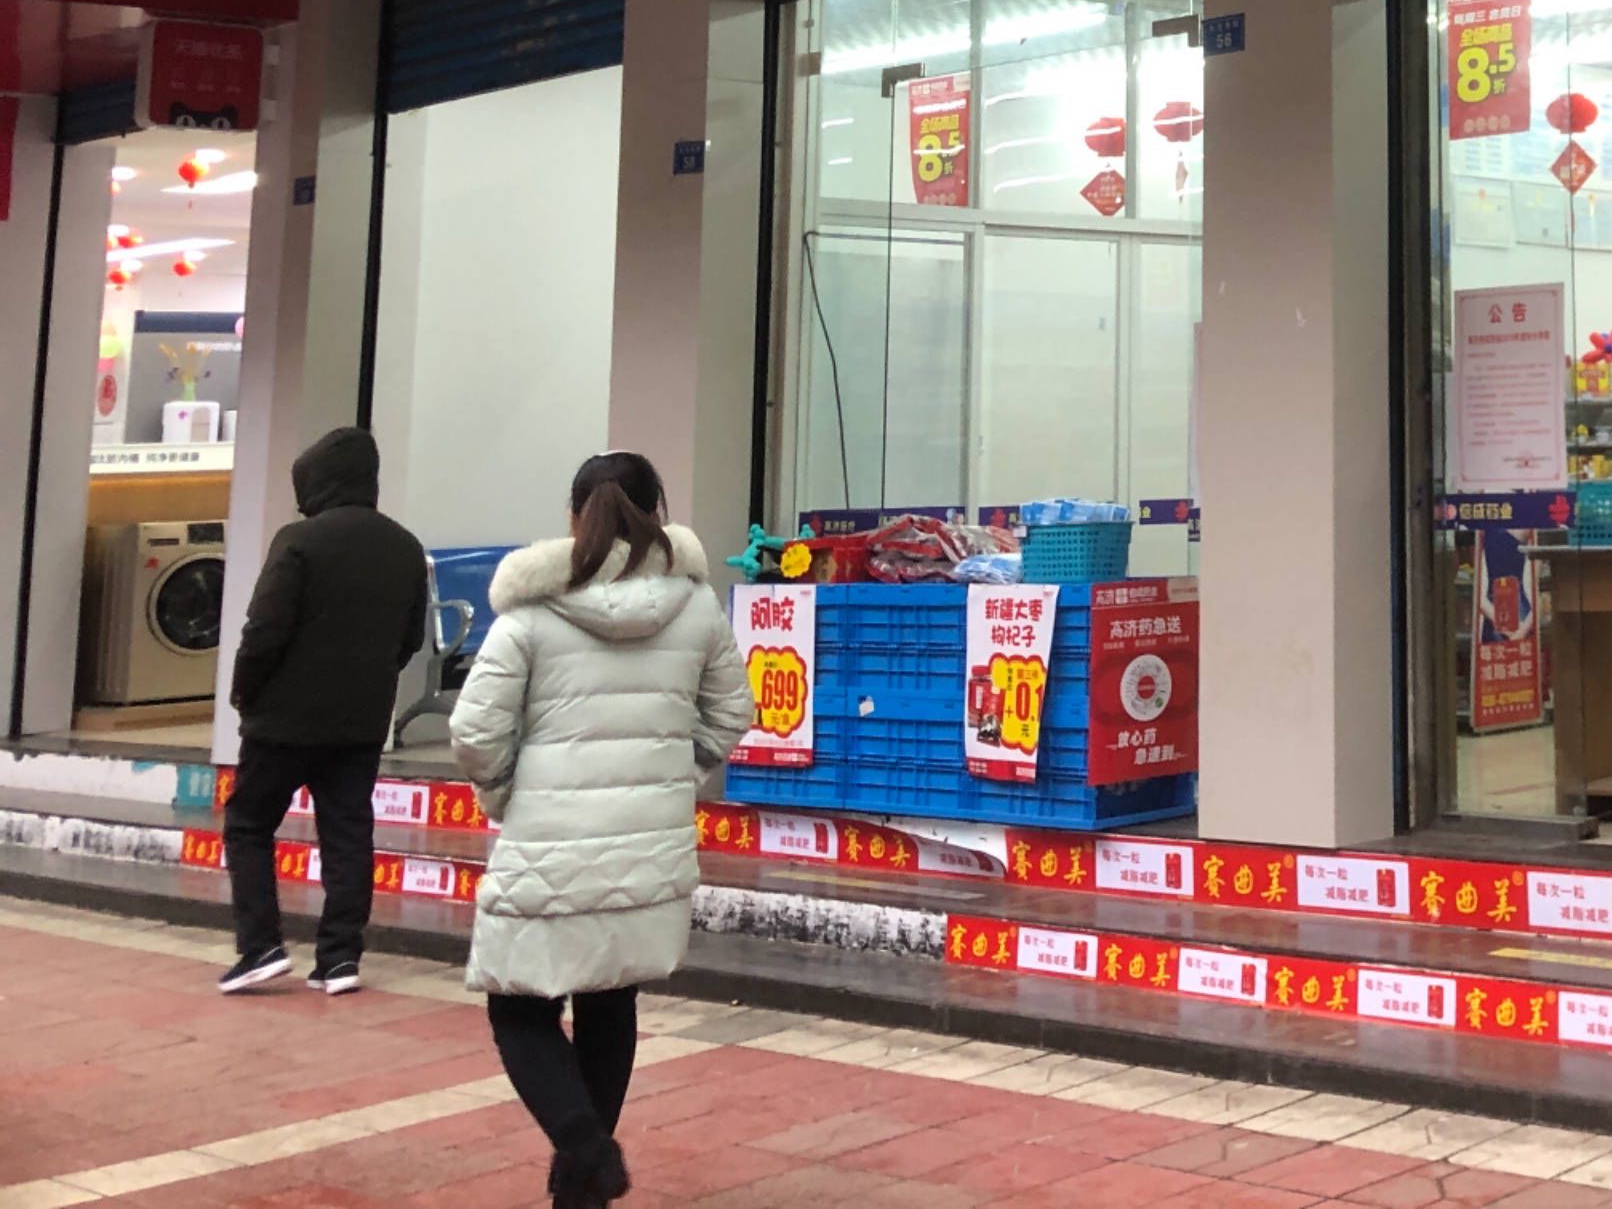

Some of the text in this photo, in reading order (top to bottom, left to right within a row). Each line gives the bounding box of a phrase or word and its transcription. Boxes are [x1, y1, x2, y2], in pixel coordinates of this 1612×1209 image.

[1489, 303, 1527, 324] 公告
[751, 596, 795, 632] 阿胶
[985, 598, 1043, 622] 新疆大枣
[992, 624, 1036, 647] 枸杞子
[1110, 616, 1183, 639] 高济药急送
[1480, 641, 1532, 662] 每次一粒
[761, 669, 800, 711] 699
[1537, 883, 1586, 900] 每次一粒
[1560, 905, 1609, 924] 减脂减肥
